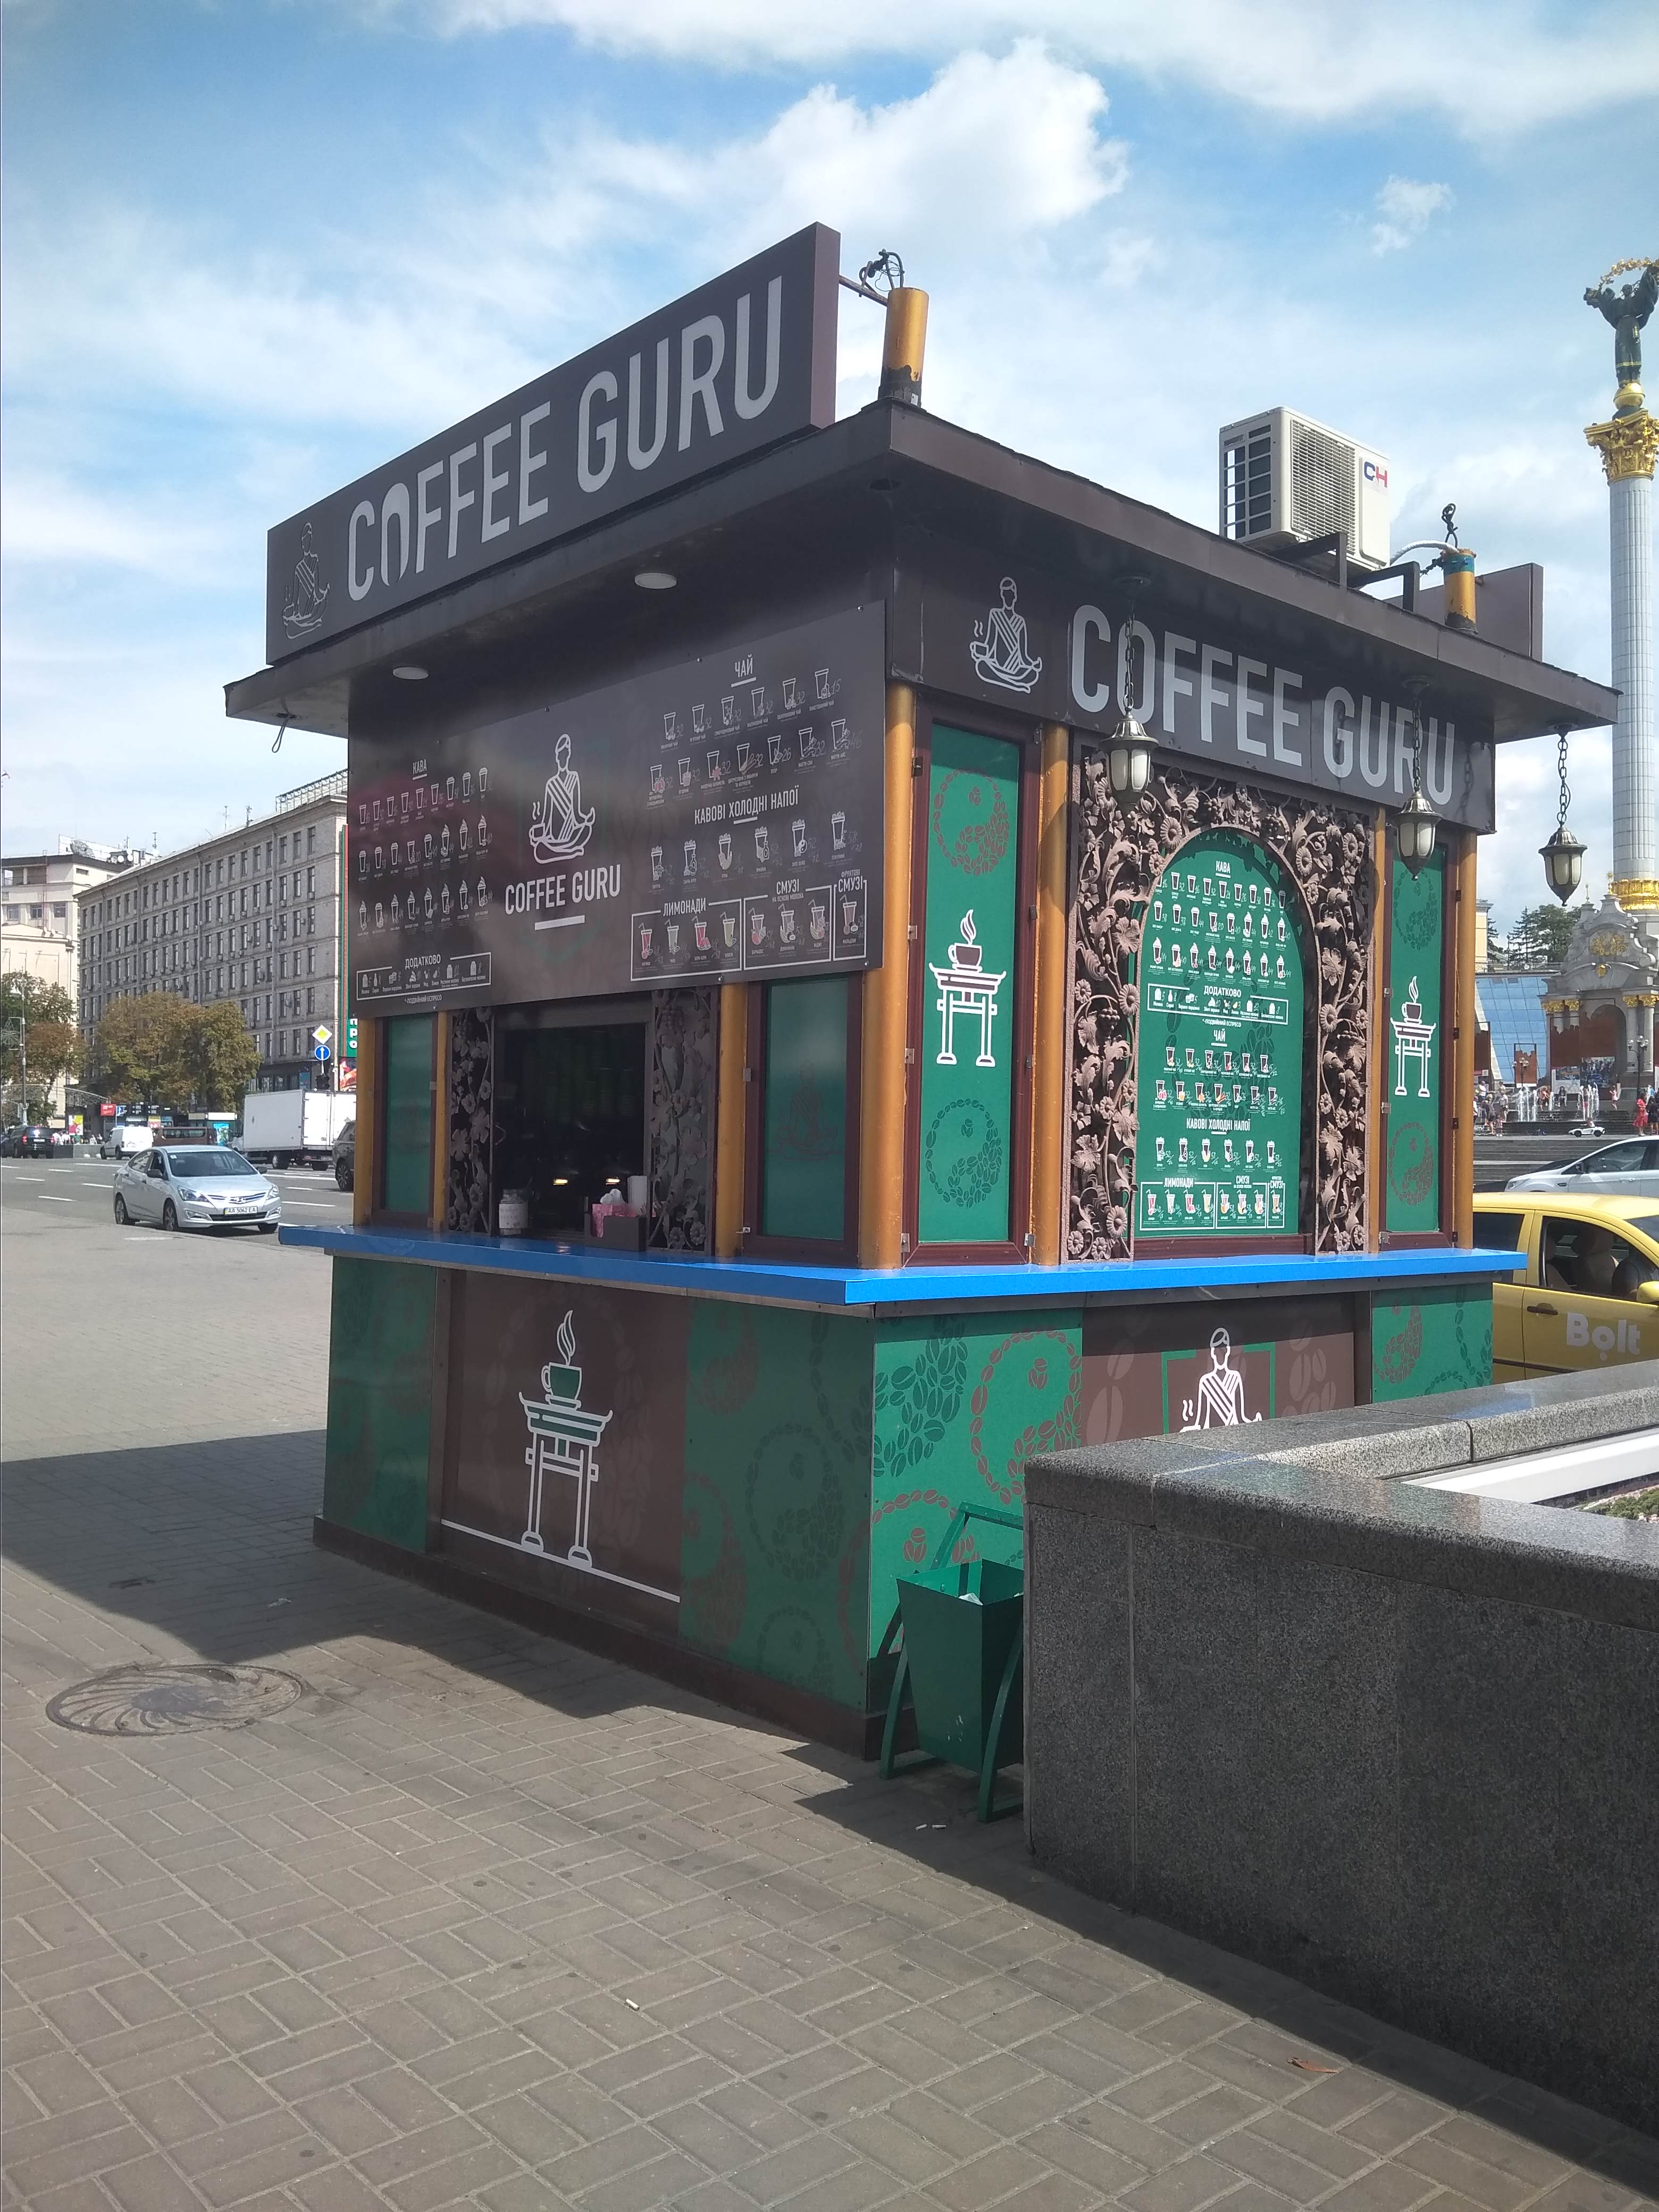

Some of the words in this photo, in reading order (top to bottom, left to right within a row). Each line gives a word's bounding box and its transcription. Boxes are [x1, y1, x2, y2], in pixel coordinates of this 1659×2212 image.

[347, 401, 550, 602] COFFEE
[576, 276, 782, 493] GURU
[735, 654, 753, 677] ЧАЙ
[1070, 605, 1303, 766] COFFEE
[1323, 686, 1455, 806] GURU
[413, 759, 427, 774] КАВА
[694, 803, 725, 825] КАВОВІ
[729, 793, 767, 816] ХОЛОДНІ
[771, 784, 799, 810] НАПОЇ
[841, 869, 860, 877] ФРУКТОВІ
[1216, 860, 1230, 874] КАВА
[505, 874, 575, 915] COFFEE
[572, 864, 621, 903] GURU
[776, 879, 799, 894] СМУЗІ
[839, 876, 862, 893] СМУЗІ
[663, 898, 706, 916] ЛИМОНАДИ
[405, 954, 441, 970] ДОДАТКОВО
[1204, 985, 1242, 998] ДОДАТКОВО
[1213, 1028, 1225, 1042] ЧАЙ
[1186, 1118, 1207, 1129] КАВОВІ
[1208, 1118, 1233, 1131] ХОЛОДНІ
[1234, 1118, 1251, 1131] НАПОЇ
[1164, 1177, 1194, 1188] ЛИМОНАДИ
[1236, 1175, 1250, 1184] СМУЗІ
[1270, 1180, 1283, 1189] СМУЗІ
[1566, 1312, 1640, 1361] Bolt
